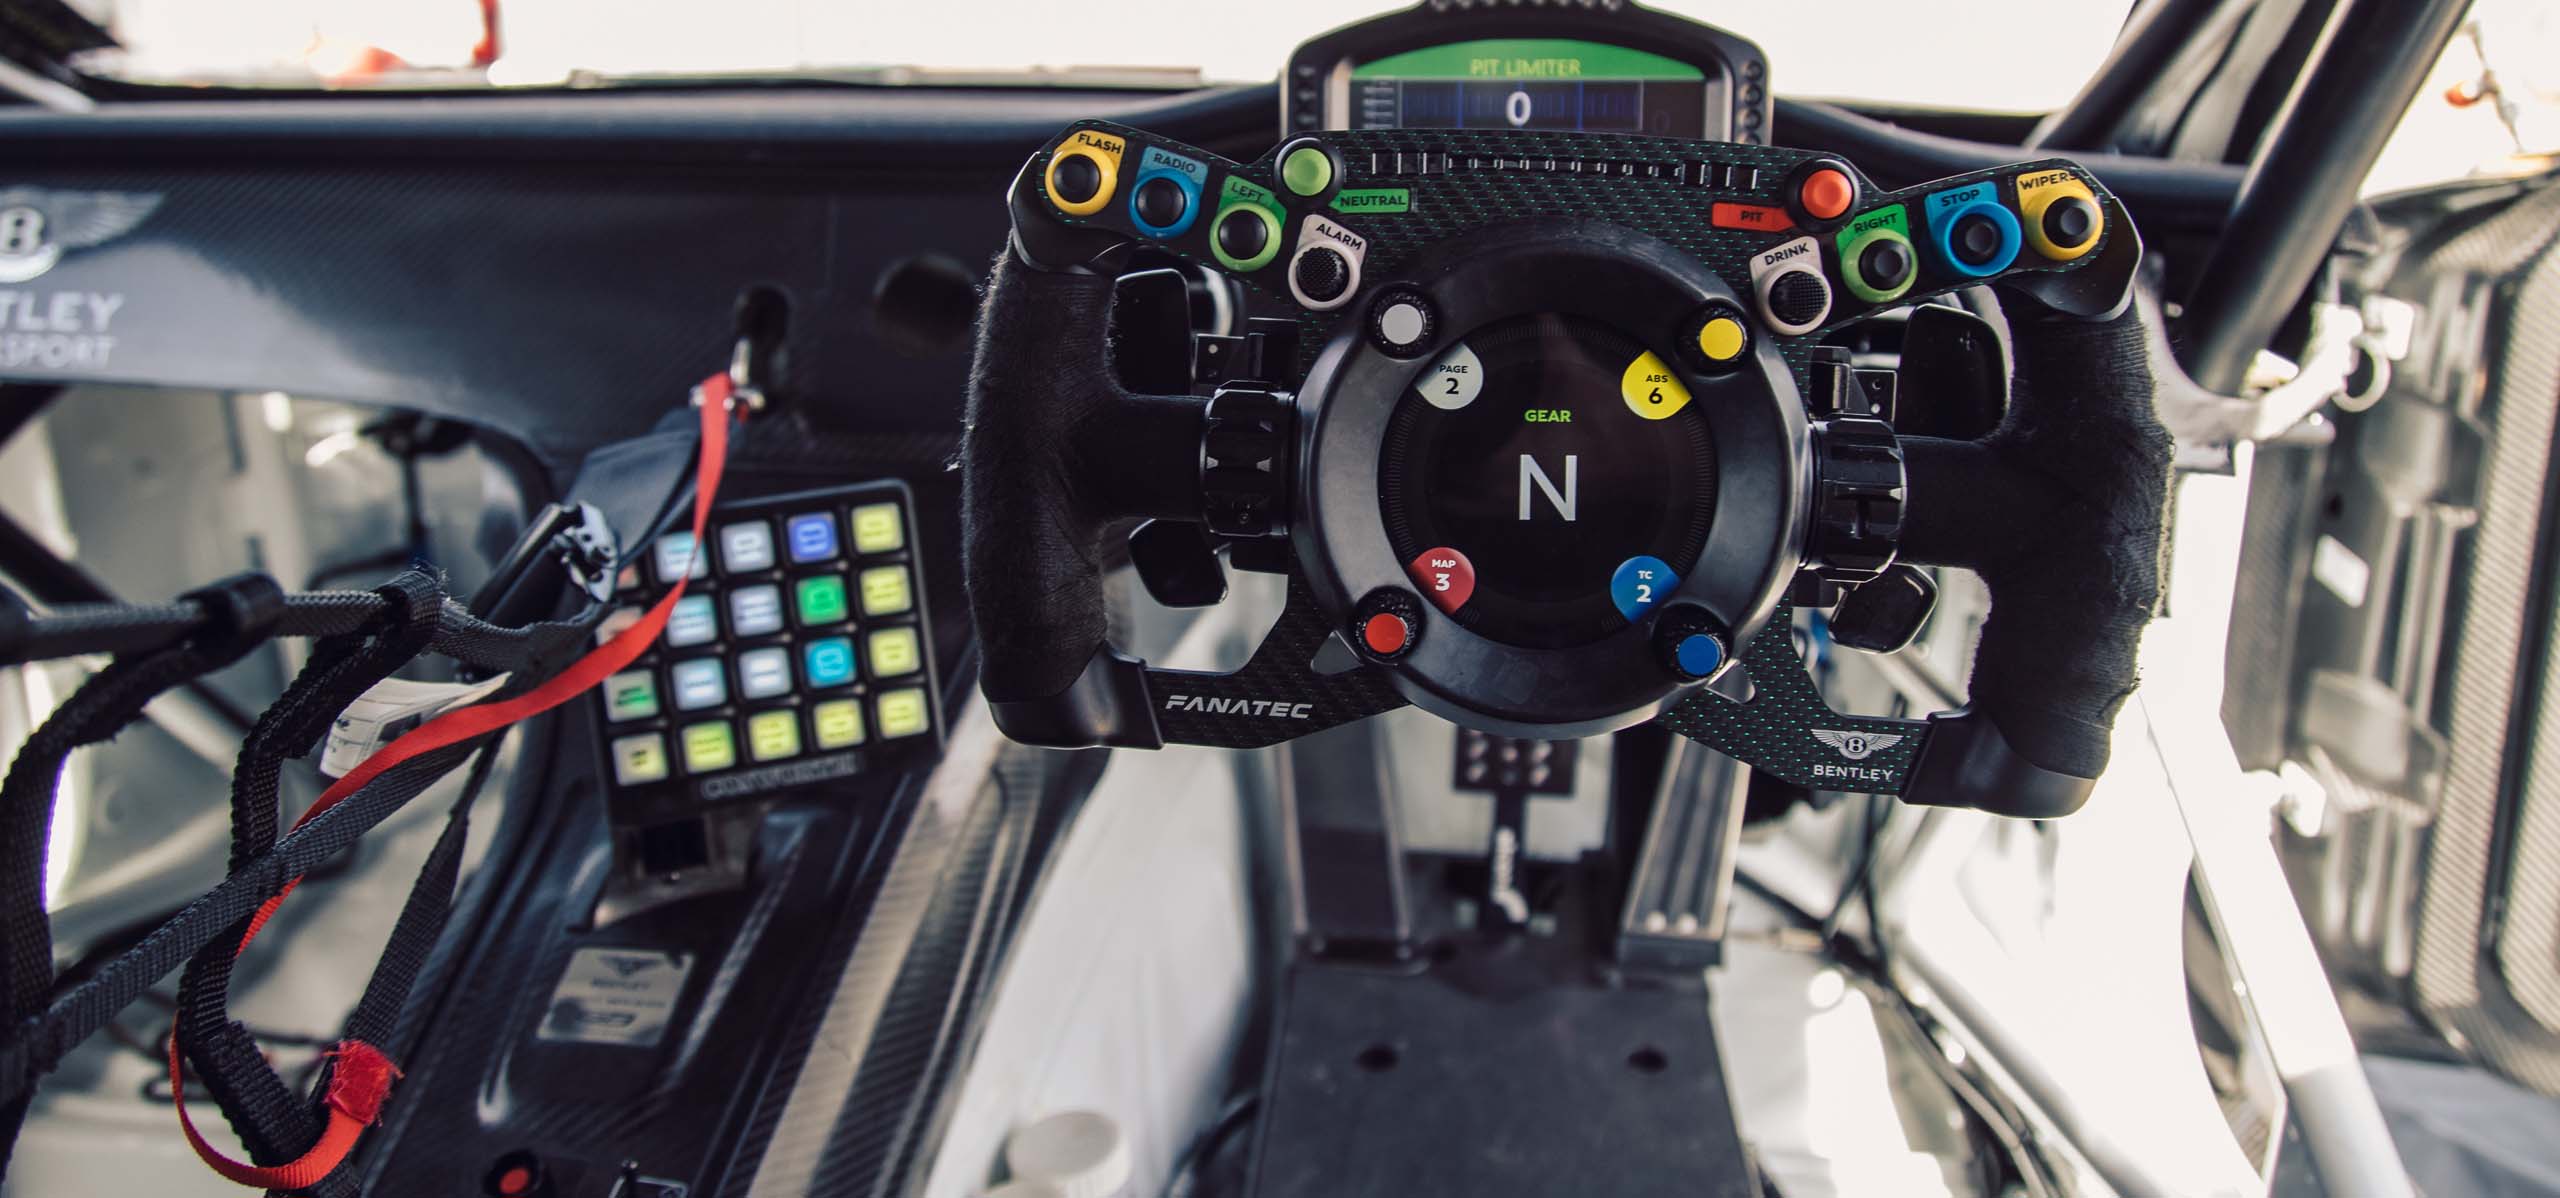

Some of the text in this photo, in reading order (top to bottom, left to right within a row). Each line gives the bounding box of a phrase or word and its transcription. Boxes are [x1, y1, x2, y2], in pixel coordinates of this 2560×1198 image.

[1471, 58, 1581, 77] PIT LIMITER
[1506, 91, 1532, 127] 0
[1078, 134, 1122, 154] FLASH
[1153, 153, 1196, 174] RADIO
[1230, 182, 1264, 202] LEFT
[1340, 195, 1406, 207] NEUTRAL
[1940, 188, 1980, 207] STOP
[1740, 210, 1764, 222] PIT
[1854, 213, 1897, 234] RIGHT
[1315, 223, 1362, 250] ALARM
[1764, 243, 1810, 266] DRINK
[1439, 364, 1468, 374] PAGE
[1446, 377, 1459, 395] 2
[1646, 374, 1668, 383] ABS
[1648, 388, 1663, 405] 6
[1524, 409, 1571, 423] GEAR
[1518, 454, 1577, 521] N
[1432, 559, 1456, 569] MAP
[1435, 573, 1450, 591] 3
[1638, 570, 1653, 580] TC
[1636, 585, 1652, 603] 2
[1165, 695, 1312, 719] FANATEC
[1813, 764, 1894, 781] BENTLEY
